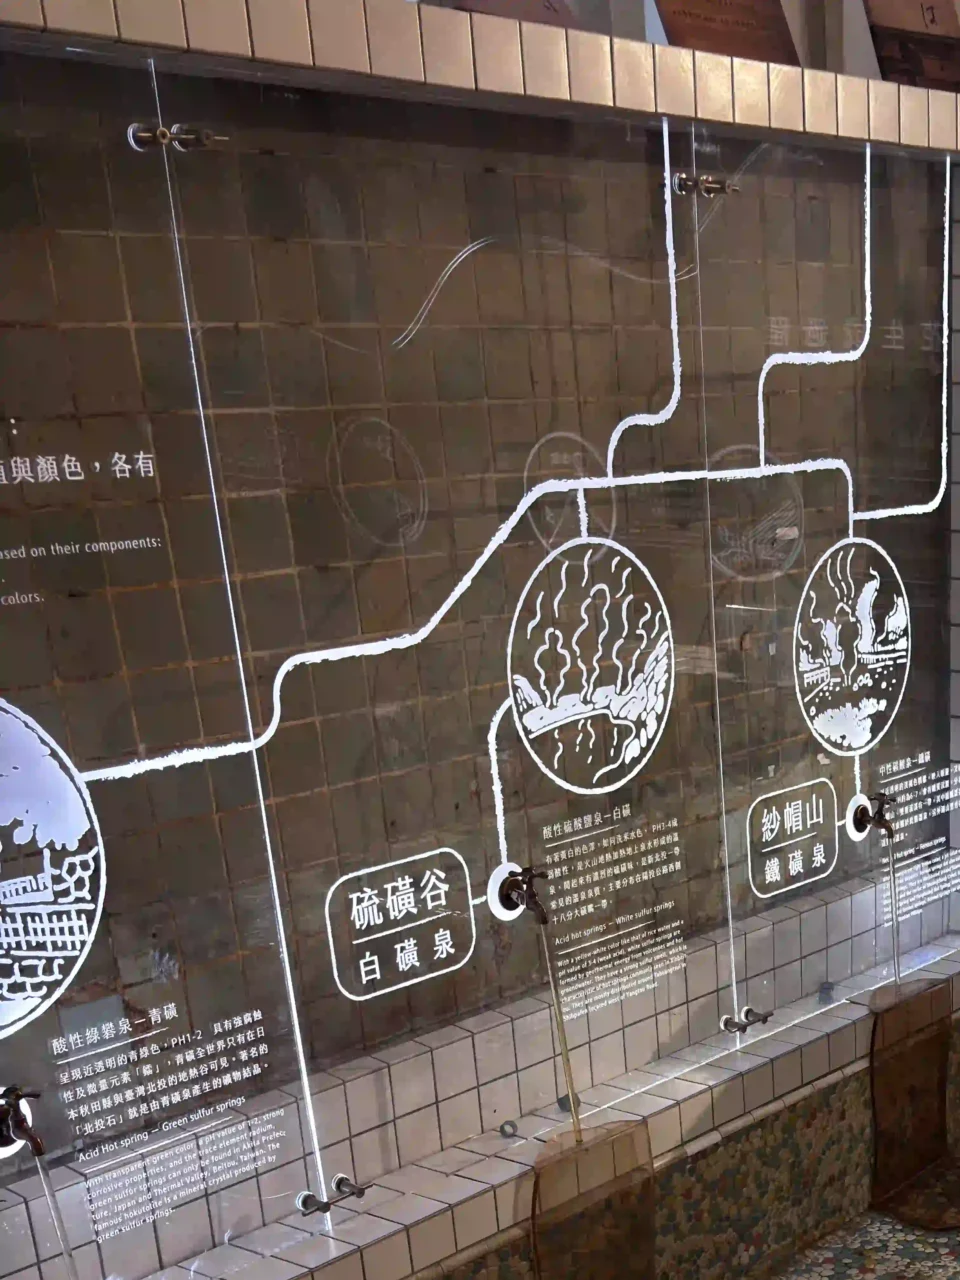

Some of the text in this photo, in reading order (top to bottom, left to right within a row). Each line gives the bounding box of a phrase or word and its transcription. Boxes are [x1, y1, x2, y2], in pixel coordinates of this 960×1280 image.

[30, 547, 47, 558] on
[51, 542, 81, 556] their
[84, 536, 162, 555] components:
[761, 793, 824, 842] 紗帽山
[764, 842, 827, 884] 鐵磺泉
[348, 867, 450, 931] 硫磺谷
[555, 899, 675, 946] Acid hot springs White sulfur springs
[358, 927, 456, 985] 白磺泉
[557, 958, 570, 969] With
[607, 941, 621, 951] color
[620, 937, 631, 946] like
[631, 933, 641, 942] that
[671, 919, 680, 928] and
[567, 965, 581, 974] value
[77, 1095, 246, 1163] Acid Hot spring Green sulfur springs
[83, 1109, 286, 1189] With transparent green value strong
[86, 1181, 124, 1200] corrosive
[169, 1157, 183, 1168] and
[184, 1153, 197, 1163] the
[218, 1132, 248, 1149] element
[89, 1148, 232, 1212] green sulfur springs only found
[93, 1157, 267, 1231] famous hokutolite mineral crystal produced
[112, 1142, 281, 1212] Japan and Thermal The
[96, 1207, 176, 1244] green sulfur springs.
